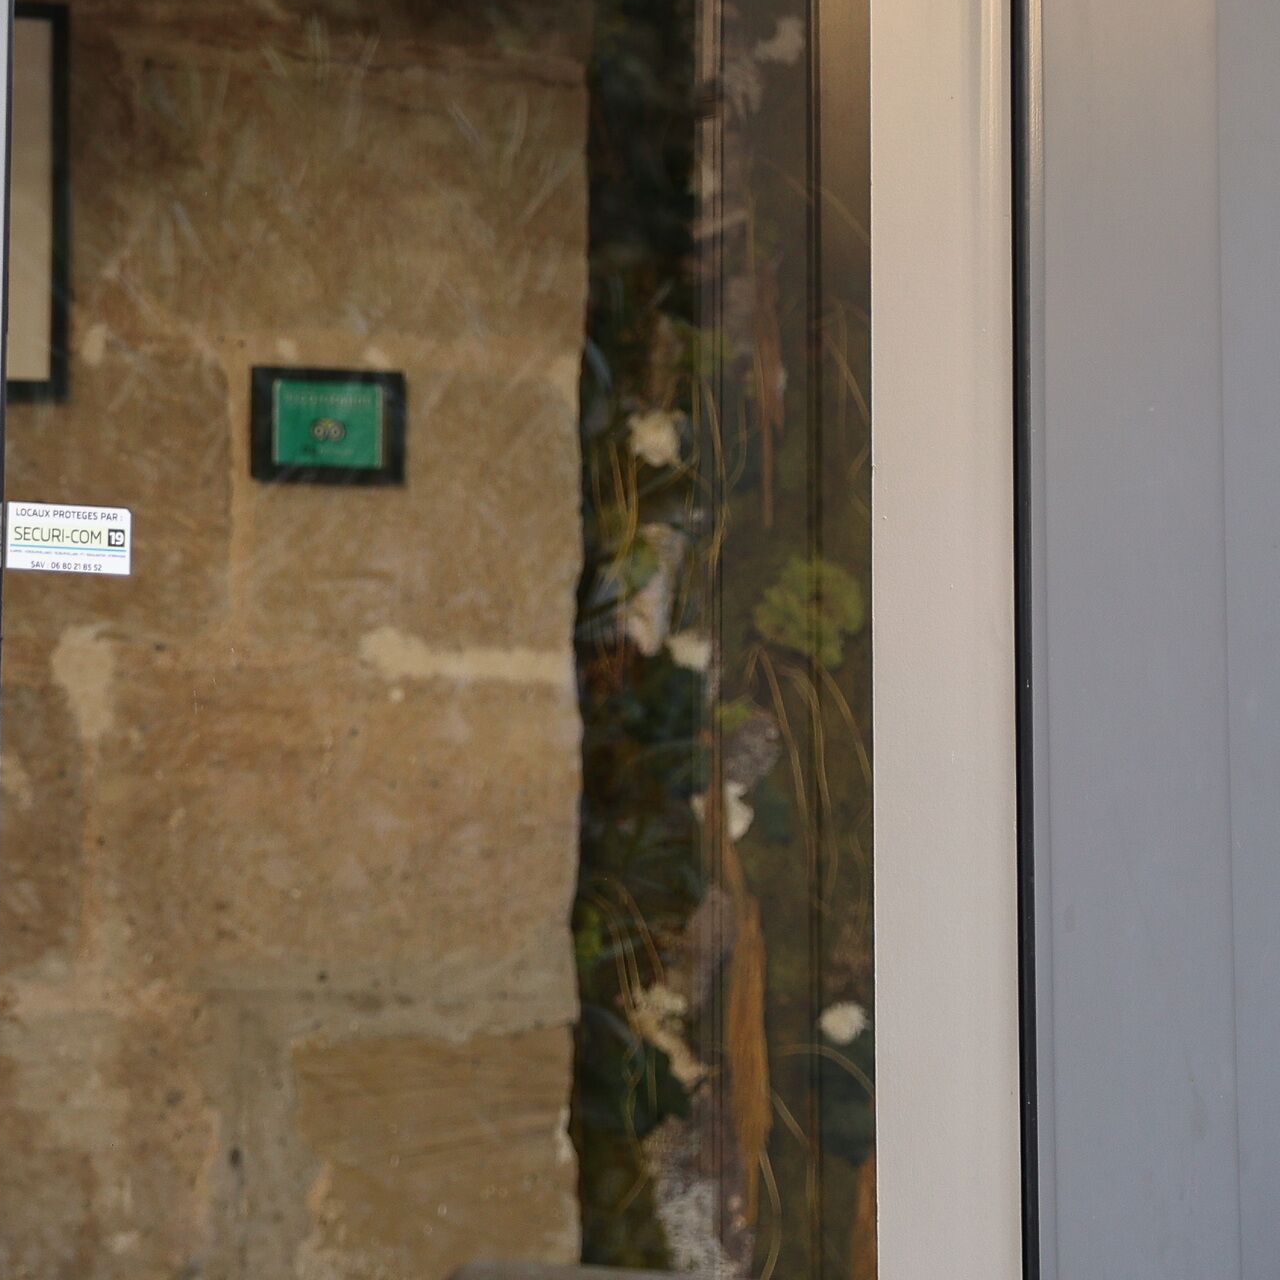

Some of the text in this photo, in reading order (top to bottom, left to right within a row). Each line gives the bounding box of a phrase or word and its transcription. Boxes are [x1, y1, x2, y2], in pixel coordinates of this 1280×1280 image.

[15, 508, 50, 518] LOCAUX
[53, 510, 98, 520] PROTEGES
[100, 512, 118, 521] PAR
[14, 526, 125, 546] SECURI-COM 19
[31, 561, 46, 569] SAV
